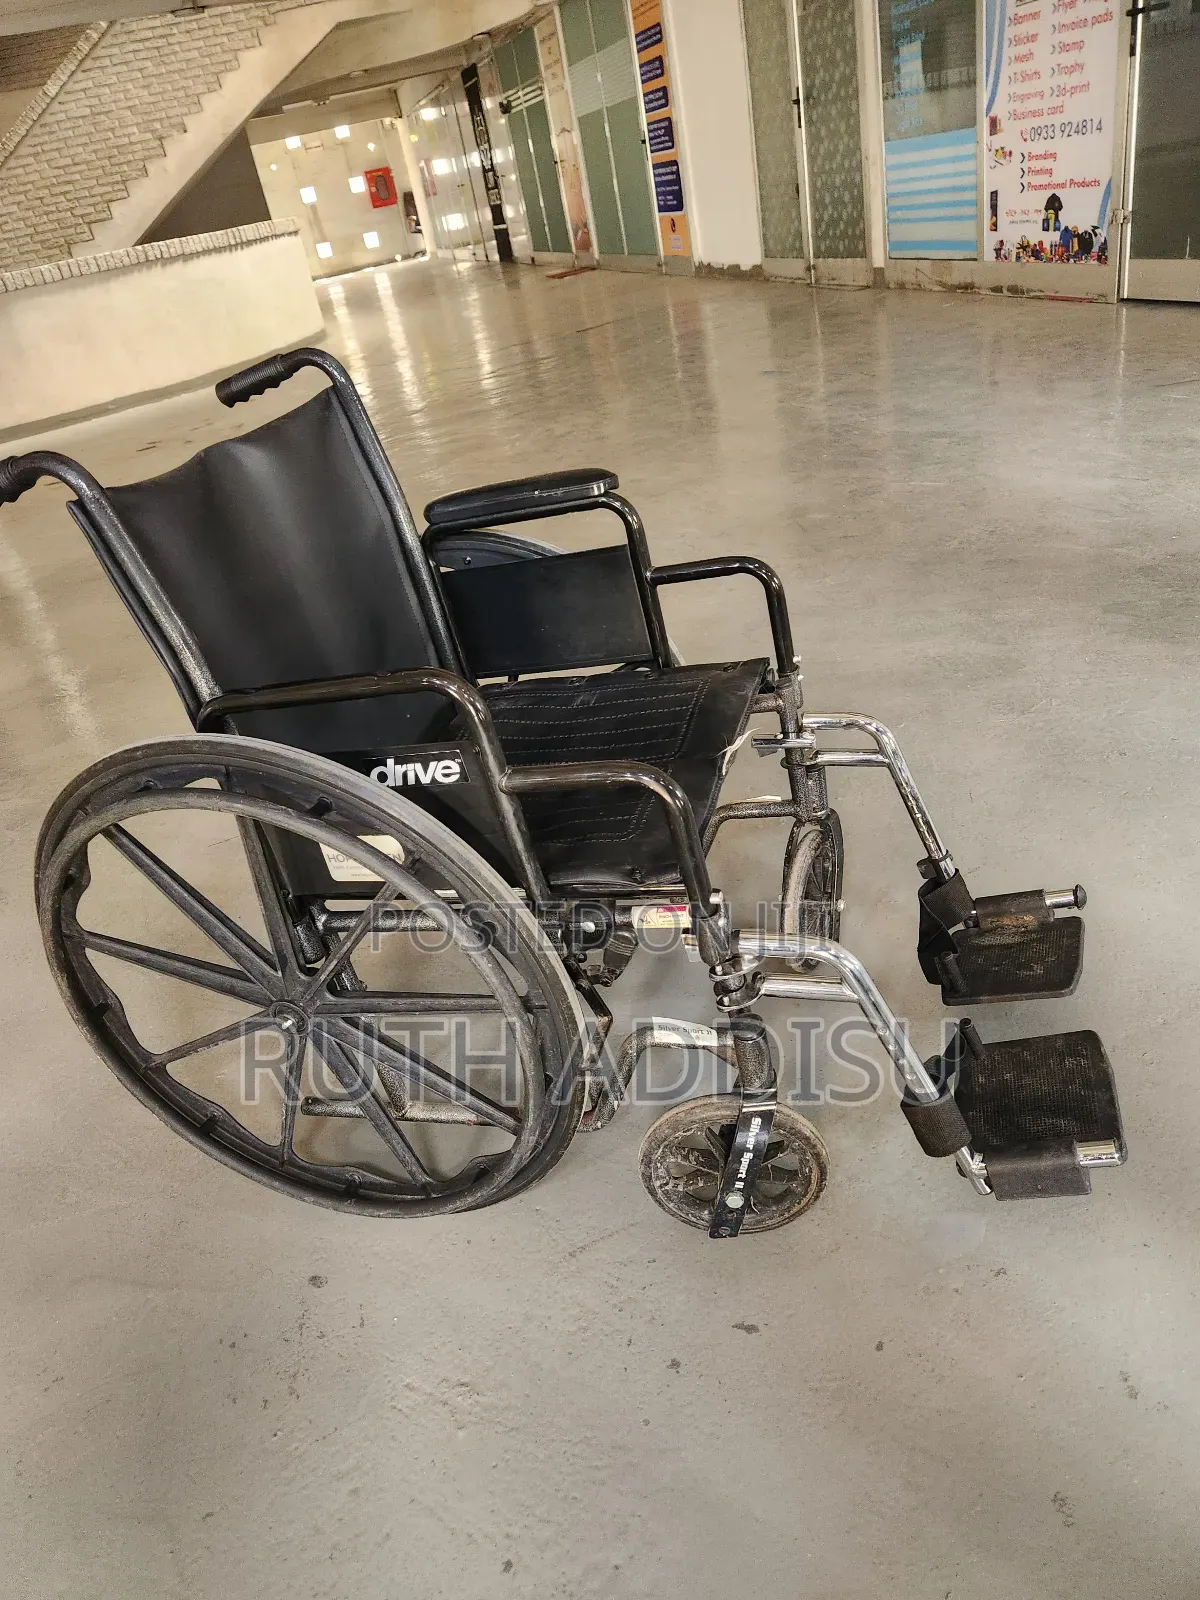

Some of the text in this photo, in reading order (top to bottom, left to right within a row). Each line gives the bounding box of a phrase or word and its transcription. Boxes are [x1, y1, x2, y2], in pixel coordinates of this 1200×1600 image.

[1013, 10, 1042, 26] Banner
[1058, 8, 1113, 34] Invoice pads
[1013, 31, 1039, 47] Sticker
[1058, 40, 1085, 55] Stamp
[1013, 48, 1034, 64] Mesh
[1013, 68, 1041, 84] T-Shirts
[1056, 61, 1085, 78] Trophy
[1012, 88, 1045, 104] Engraving
[1055, 81, 1090, 99] 3d-print
[1012, 100, 1065, 121] Business card
[1029, 118, 1103, 142] 0933 924814
[1027, 150, 1057, 162] Branding
[1027, 166, 1053, 177] Printing
[1027, 178, 1101, 192] Promotional Products
[369, 758, 461, 788] drive
[658, 1024, 680, 1032] Silver
[682, 1026, 704, 1035] Sport
[746, 1116, 762, 1150] Silver
[737, 1152, 753, 1179] Sport
